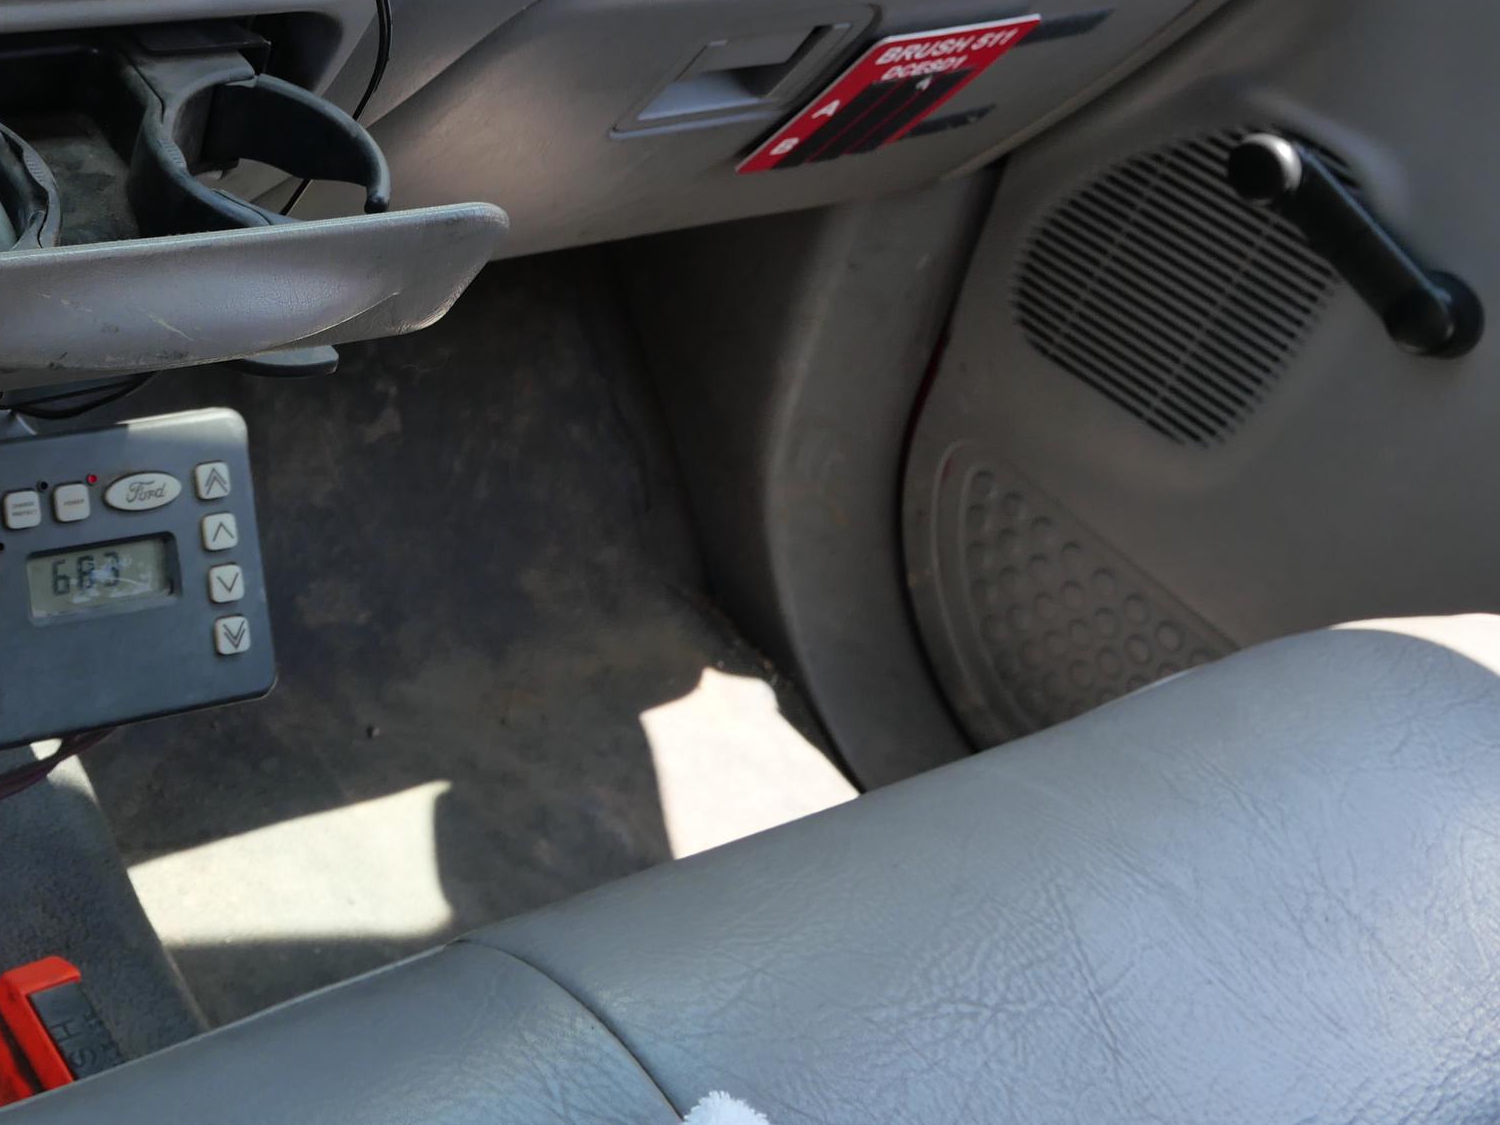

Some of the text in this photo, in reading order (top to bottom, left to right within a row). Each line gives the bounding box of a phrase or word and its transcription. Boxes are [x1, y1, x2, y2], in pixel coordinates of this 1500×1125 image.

[875, 35, 976, 65] BRUSH
[811, 99, 841, 119] A
[769, 137, 800, 156] B
[125, 480, 167, 504] Ford
